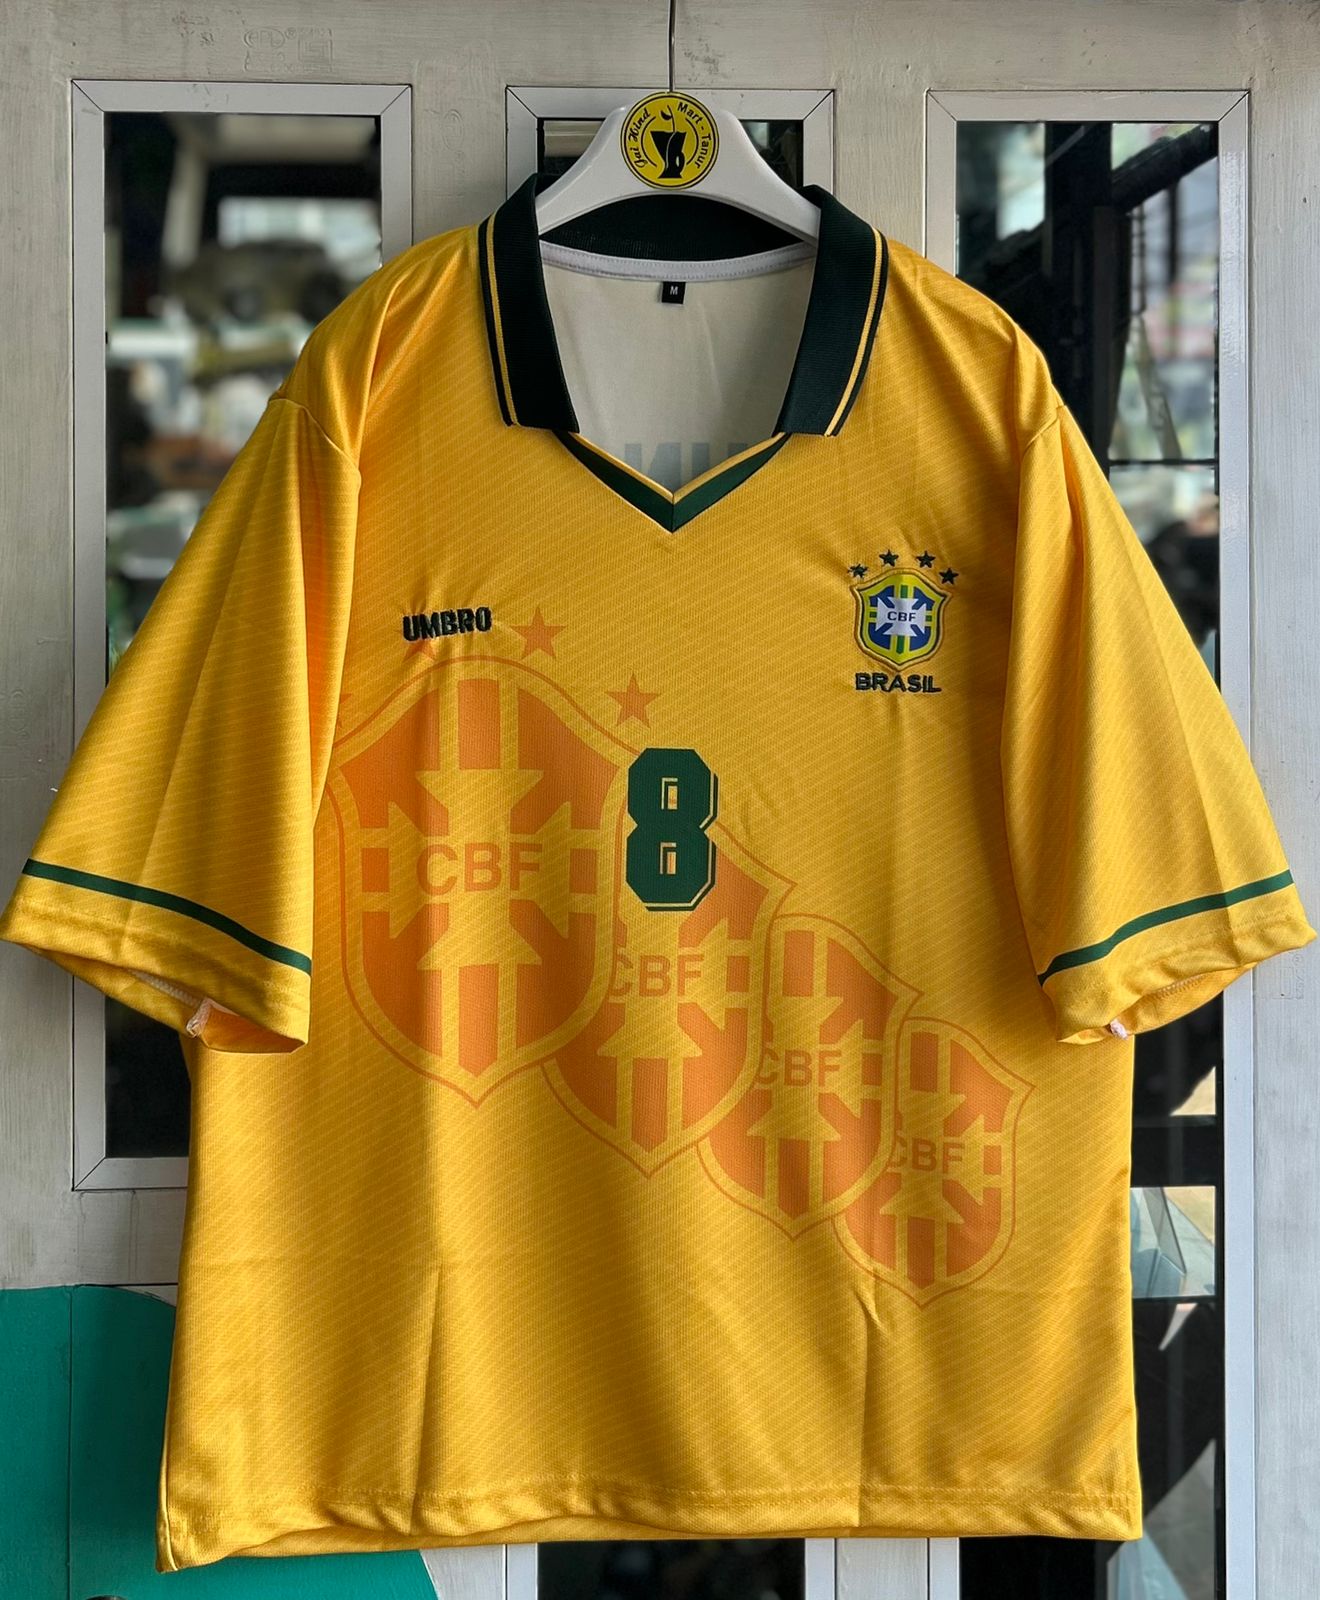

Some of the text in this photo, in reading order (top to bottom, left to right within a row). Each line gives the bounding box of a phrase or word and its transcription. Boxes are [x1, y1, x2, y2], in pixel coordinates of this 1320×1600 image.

[628, 107, 651, 142] Hind
[677, 102, 703, 124] Mart
[630, 146, 648, 168] Jai
[694, 133, 711, 169] Tanur
[670, 285, 679, 295] M
[402, 606, 492, 641] UMBRO
[887, 611, 937, 622] CBF
[855, 672, 942, 693] BRASIL
[626, 747, 718, 911] 8
[416, 841, 542, 896] CBF
[607, 953, 704, 998] CBF
[756, 1049, 842, 1087] CBF
